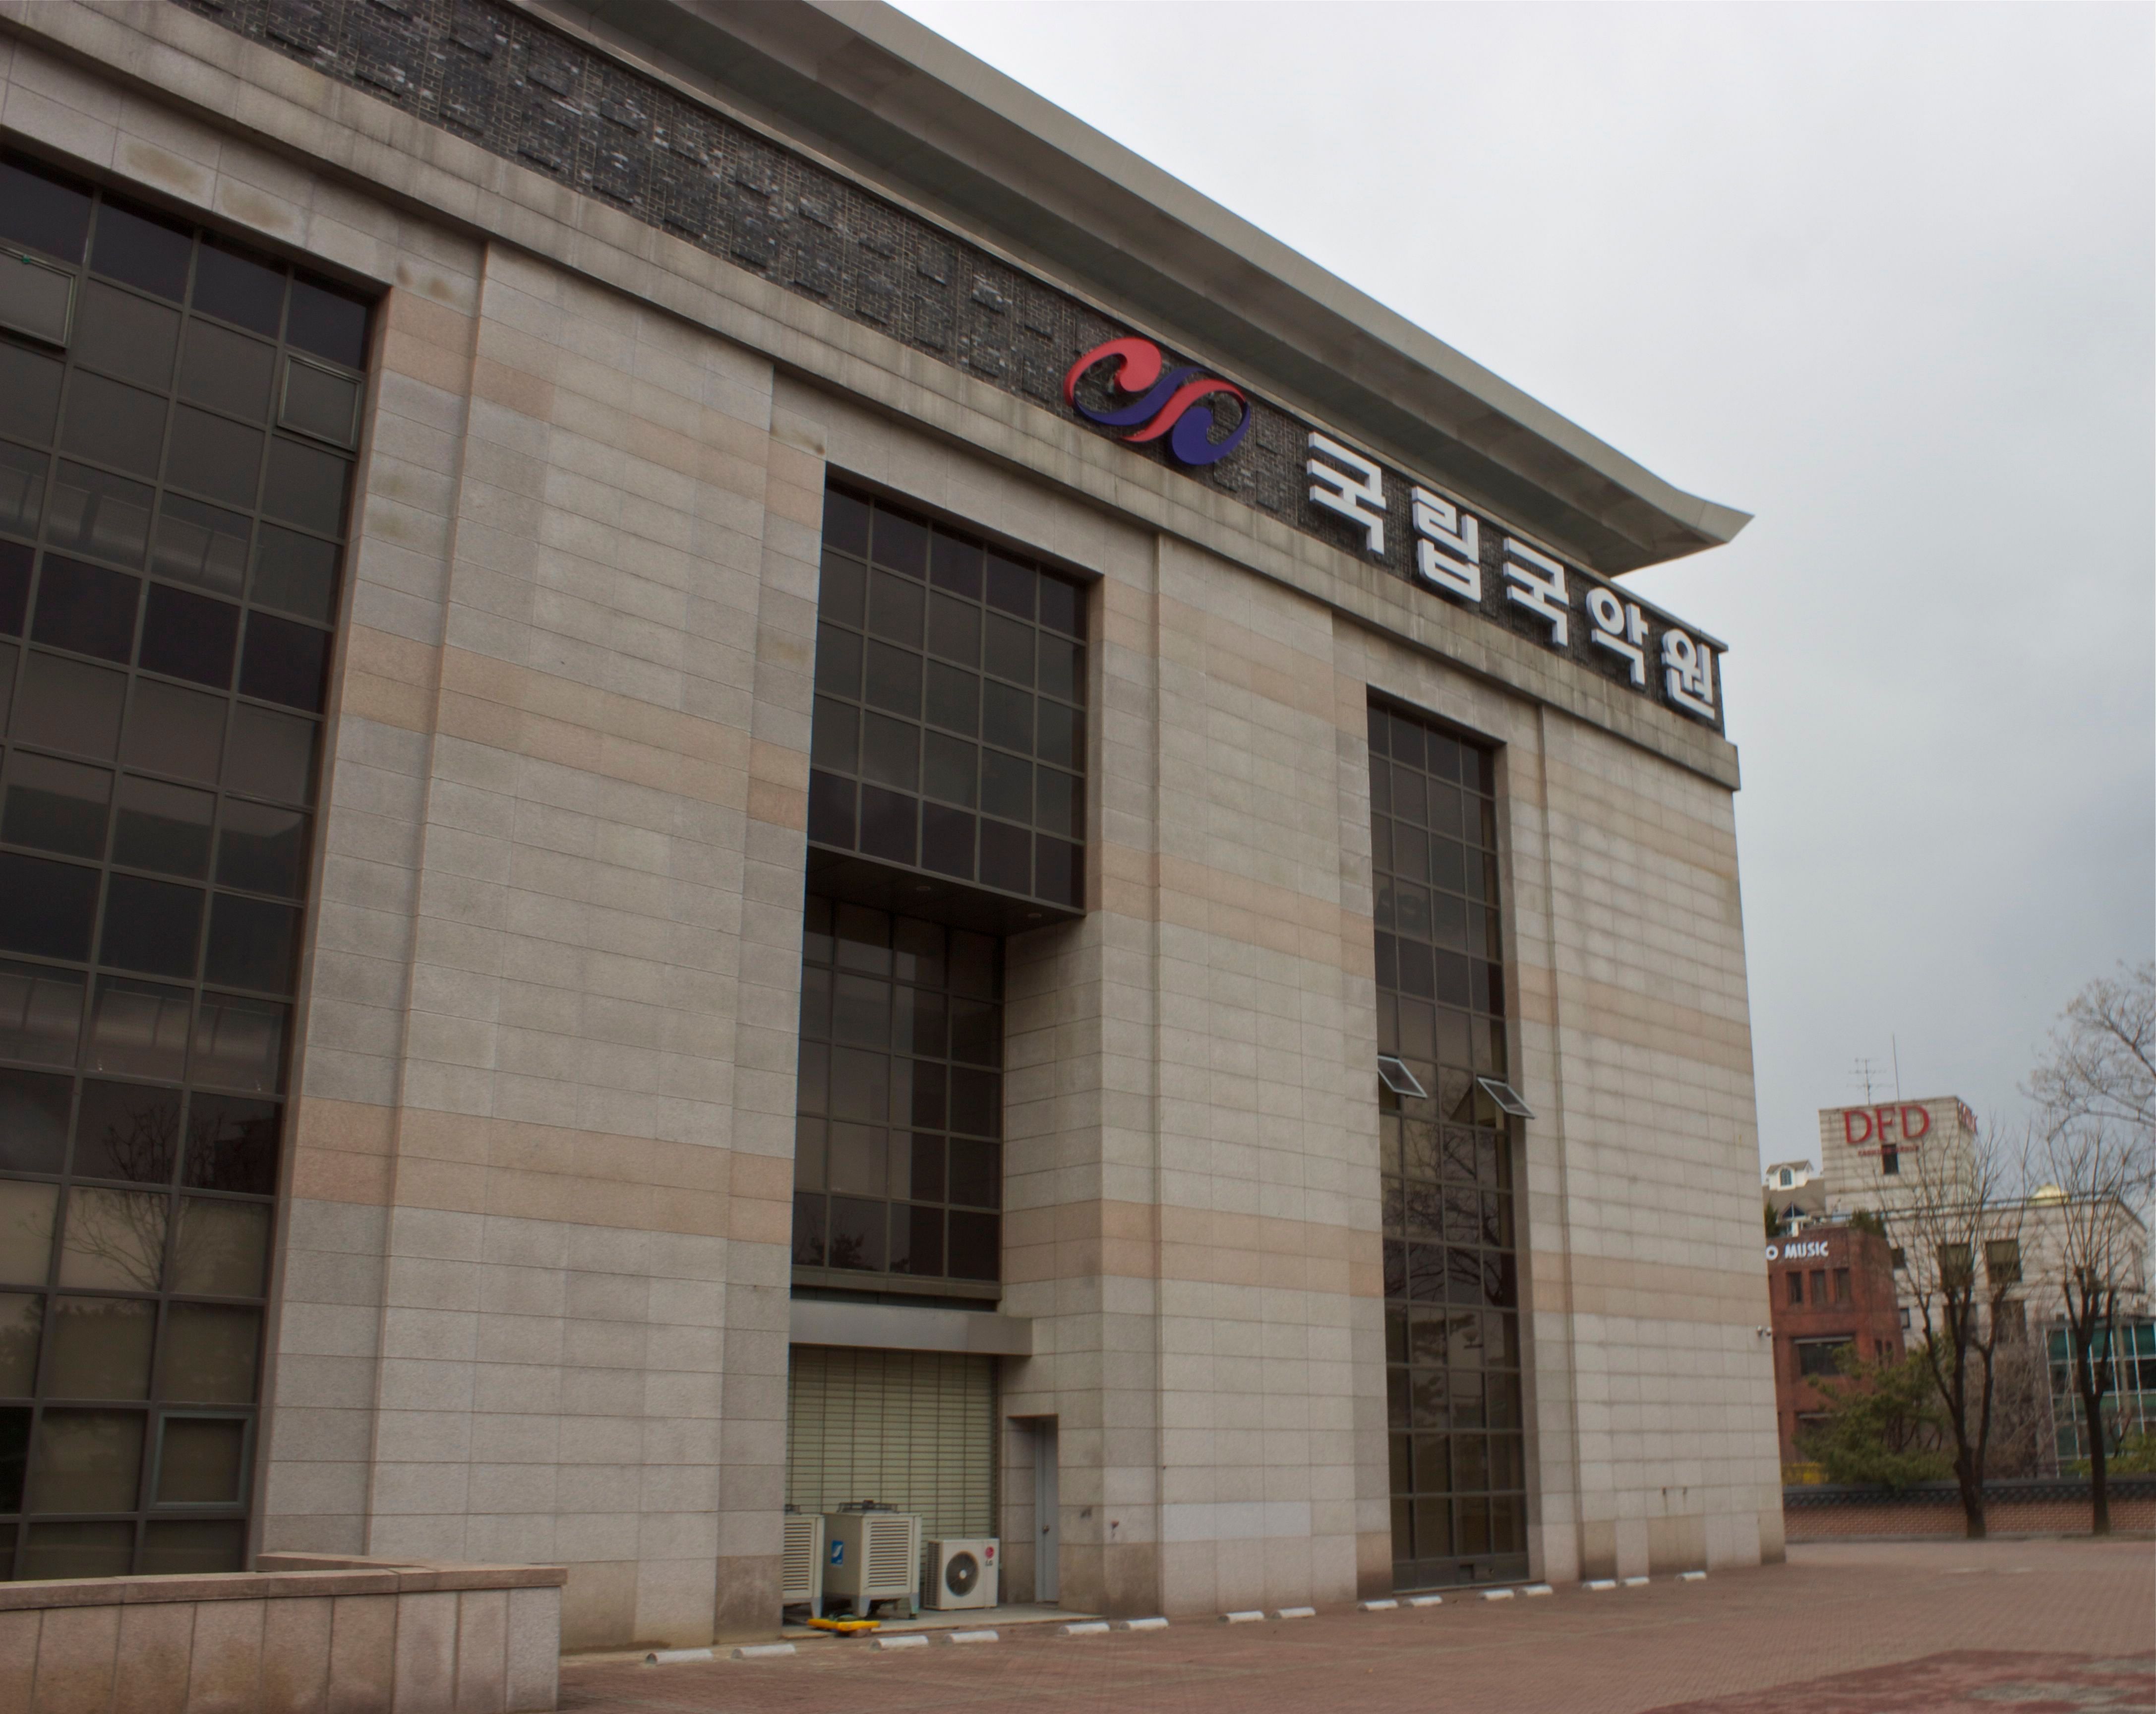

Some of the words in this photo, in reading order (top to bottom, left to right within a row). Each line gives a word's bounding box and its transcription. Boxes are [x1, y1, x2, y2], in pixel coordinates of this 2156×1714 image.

[1307, 431, 1716, 720] 국립국악원
[1843, 1104, 1930, 1144] DFD
[1785, 1241, 1829, 1259] MUSIC
